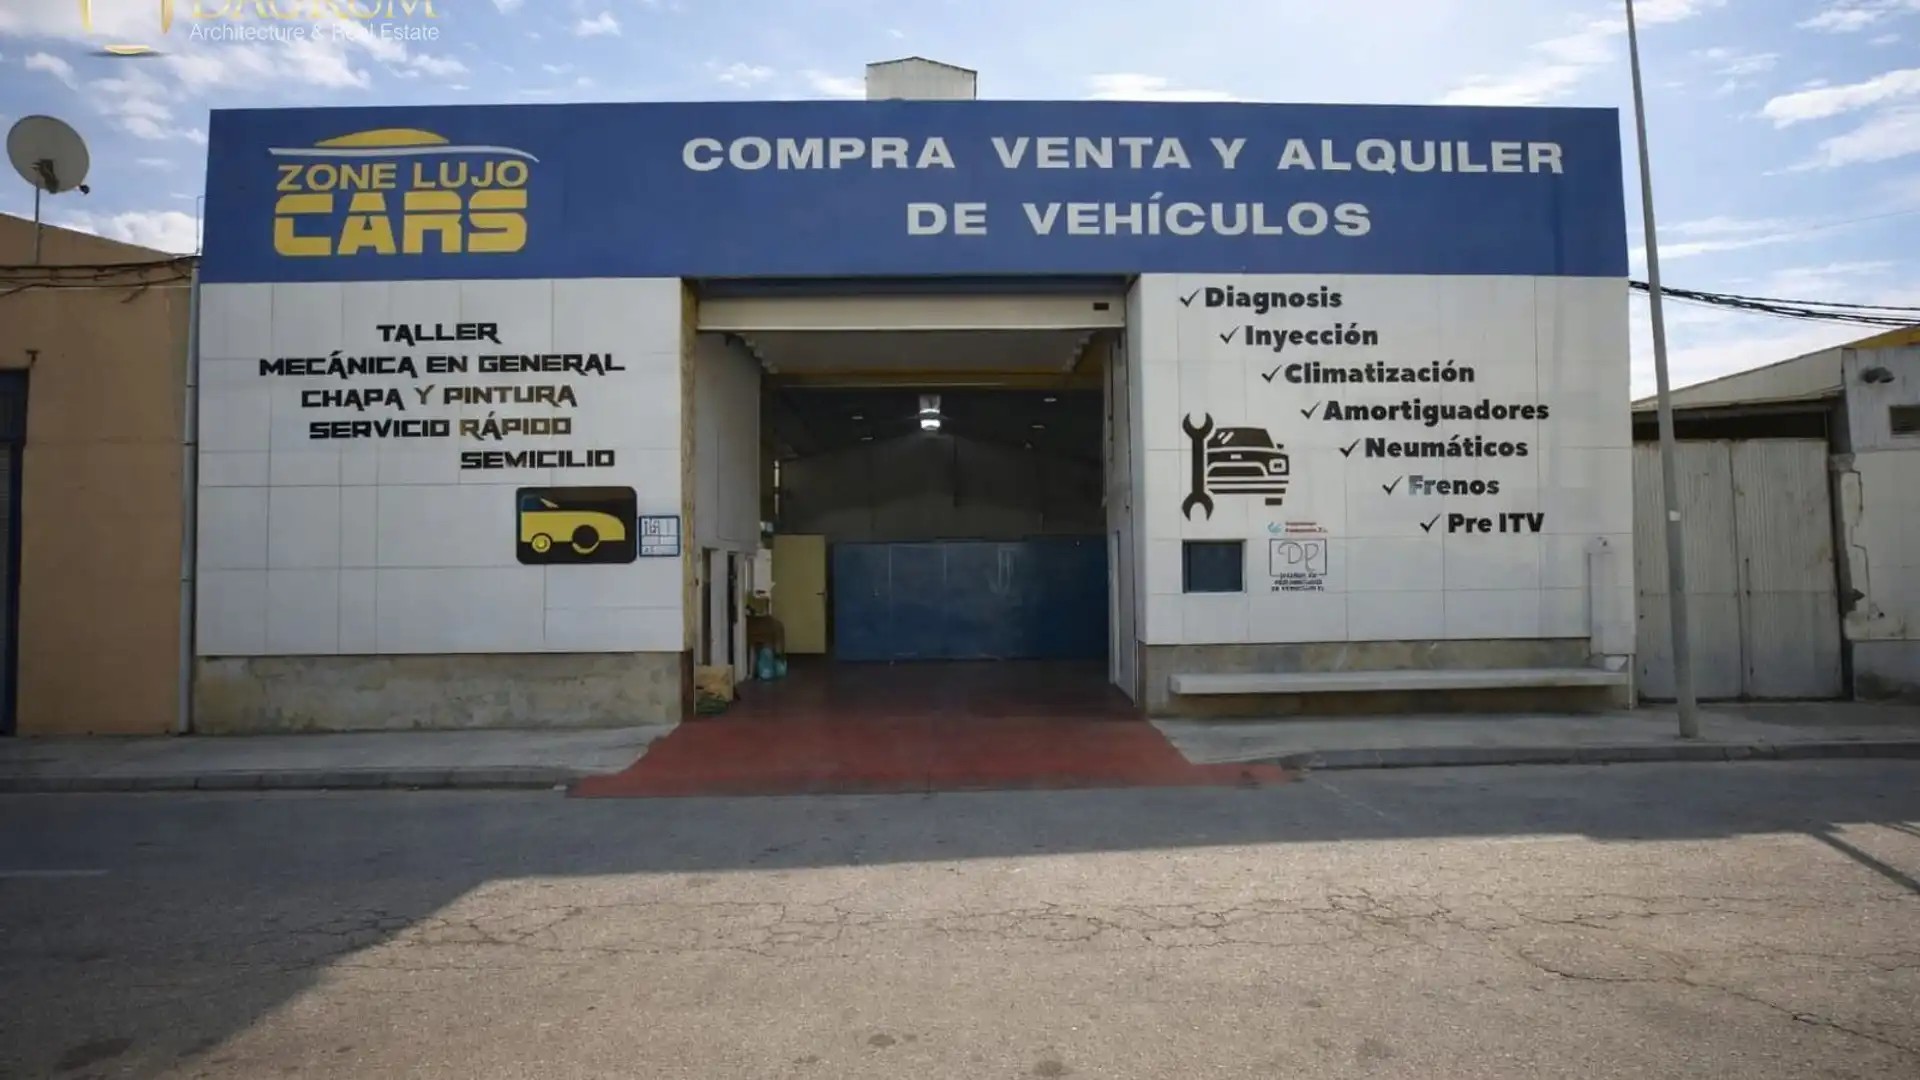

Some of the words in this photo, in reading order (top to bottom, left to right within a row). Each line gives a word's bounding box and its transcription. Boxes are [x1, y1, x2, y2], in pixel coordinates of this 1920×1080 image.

[682, 136, 956, 171] COMPRA
[992, 136, 1191, 169] VENTA
[1210, 137, 1246, 169] Y
[1277, 138, 1564, 176] ALQUILER
[277, 163, 397, 192] ZONE
[412, 160, 528, 189] LUJO
[273, 189, 528, 256] CARS
[907, 202, 987, 235] DE
[1023, 191, 1371, 236] VEHÍCULOS
[1205, 286, 1342, 314] Diagnosis
[376, 322, 502, 347] TALLER
[1245, 323, 1378, 352] Inyección
[259, 350, 418, 379] MECÁNICA
[426, 355, 468, 373] EN
[478, 353, 626, 377] GENERAL
[1284, 359, 1475, 384] Climatización
[301, 388, 405, 411] CHAPA
[413, 384, 436, 406] Y
[443, 384, 578, 408] PINTURA
[308, 418, 451, 439] SERVICIO
[459, 411, 572, 440] RÁPIDO
[1323, 398, 1550, 427] Amortiguadores
[1365, 434, 1529, 458] Neumáticos
[1407, 474, 1501, 496] Frenos
[1447, 512, 1493, 534] Pre
[1498, 511, 1545, 533] ITV
